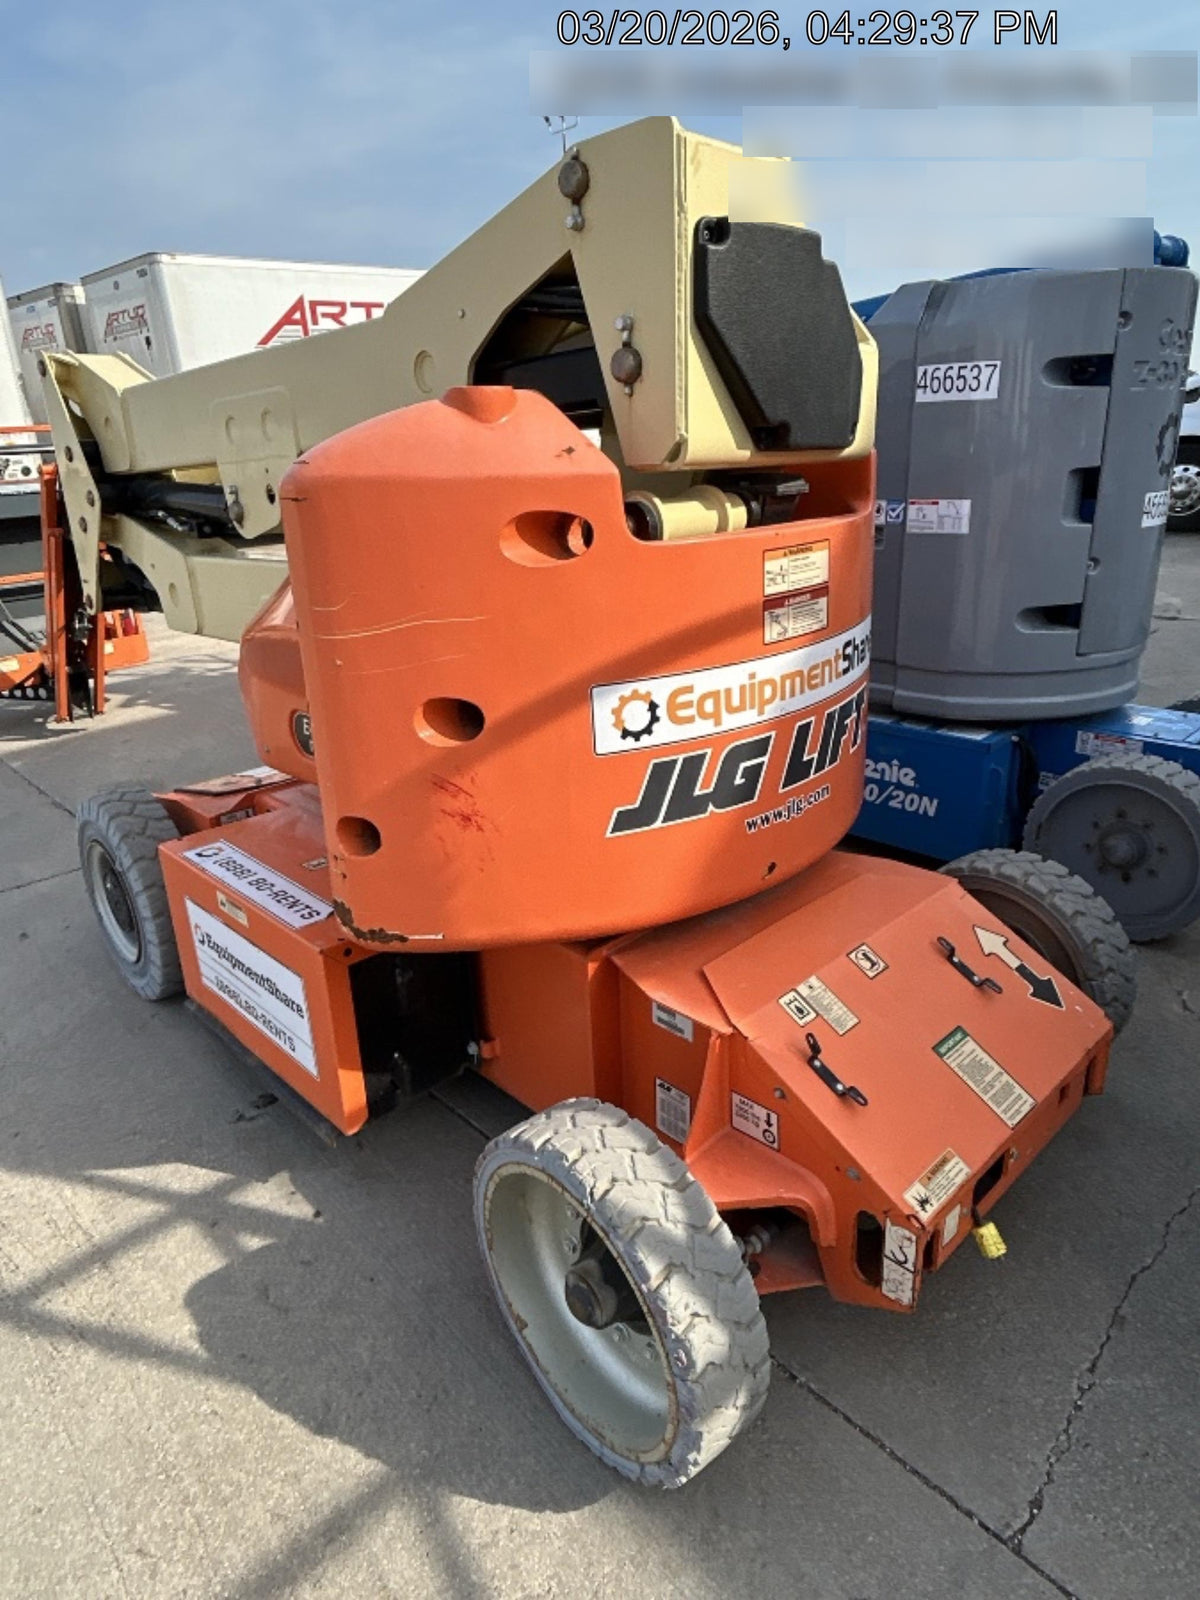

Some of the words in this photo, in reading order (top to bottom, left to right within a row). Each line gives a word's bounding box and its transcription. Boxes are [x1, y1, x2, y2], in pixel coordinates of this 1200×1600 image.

[255, 293, 385, 346] ART
[917, 364, 998, 394] 466537
[604, 730, 778, 838] JLG
[864, 758, 917, 788] enie
[745, 784, 830, 834] www.jlg.com
[864, 783, 940, 817] 0/20N
[205, 931, 305, 1019] EquipmentShare
